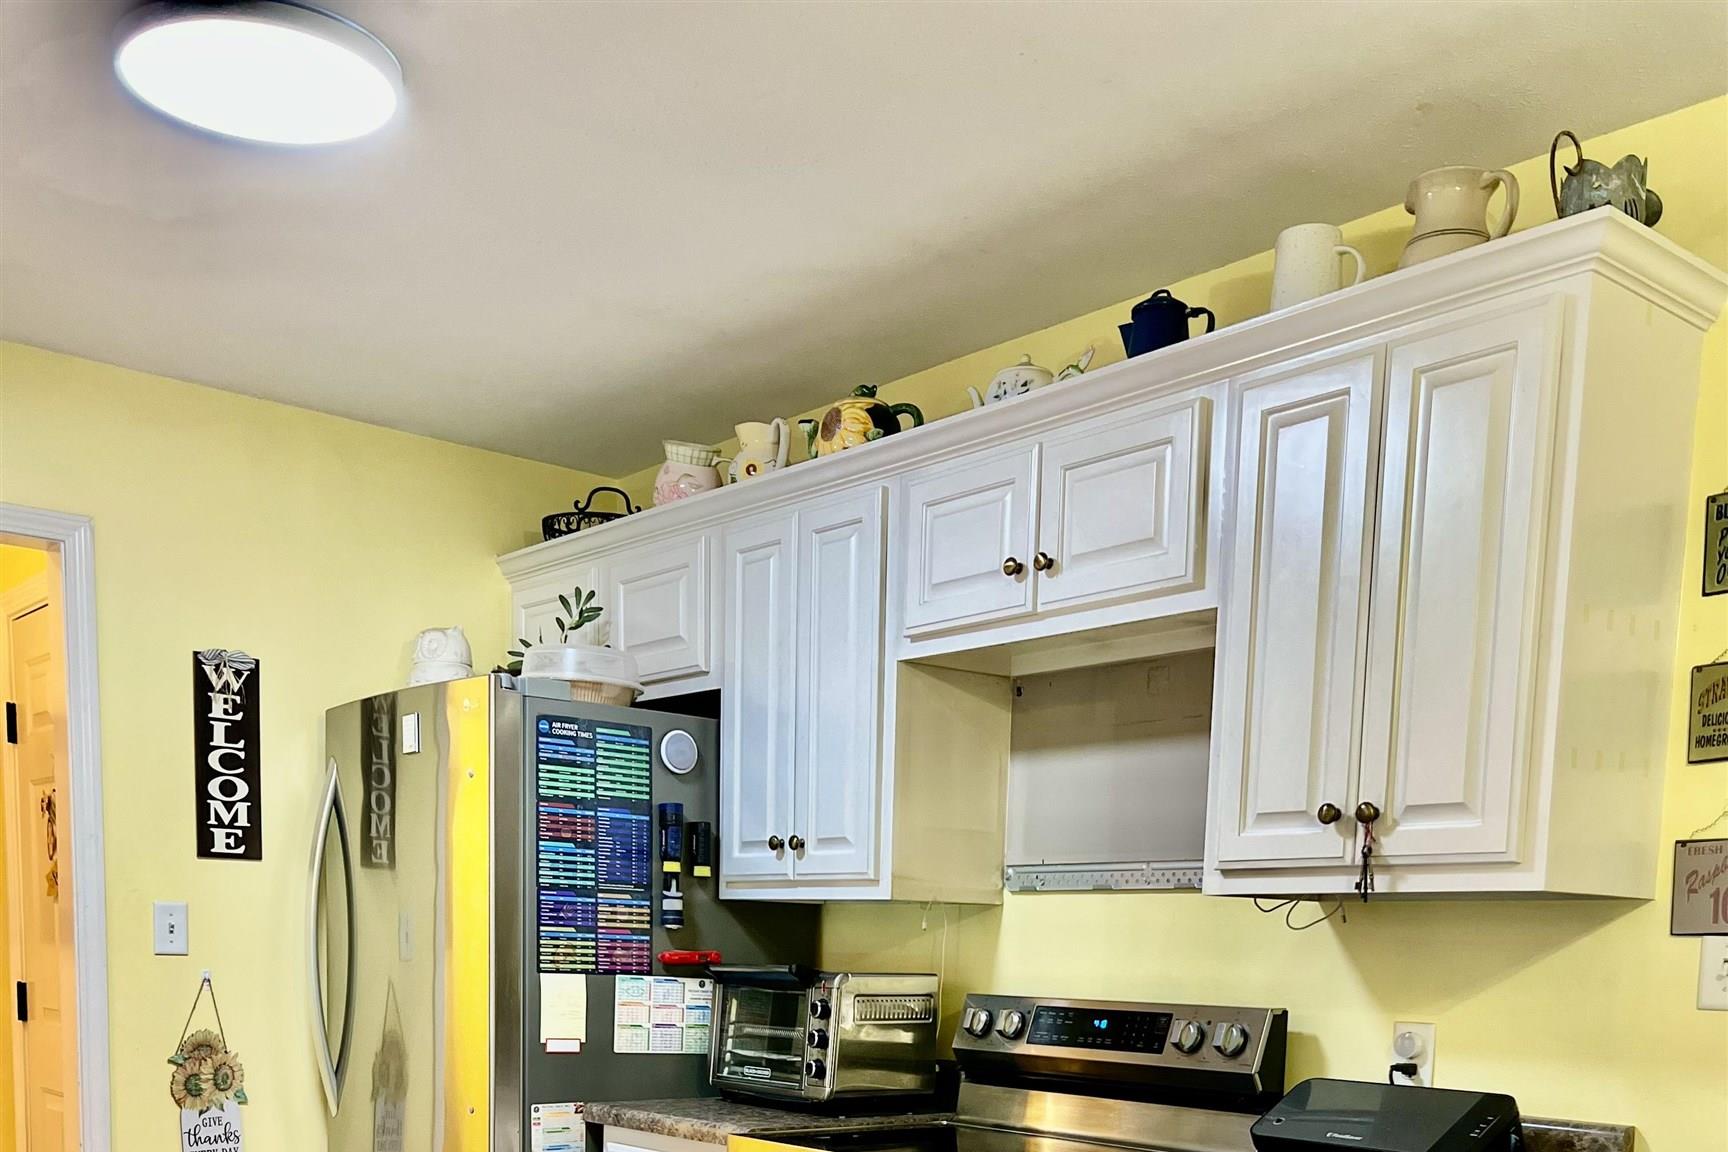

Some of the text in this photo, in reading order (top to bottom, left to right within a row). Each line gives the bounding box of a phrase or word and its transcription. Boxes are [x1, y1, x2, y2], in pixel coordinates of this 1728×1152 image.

[561, 722, 579, 730] FRYER
[551, 728, 593, 739] COOKING TIMES
[202, 664, 251, 855] WELCOME
[1687, 844, 1723, 857] FRESH
[202, 1116, 223, 1127] GIVE
[184, 1121, 241, 1147] thanks
